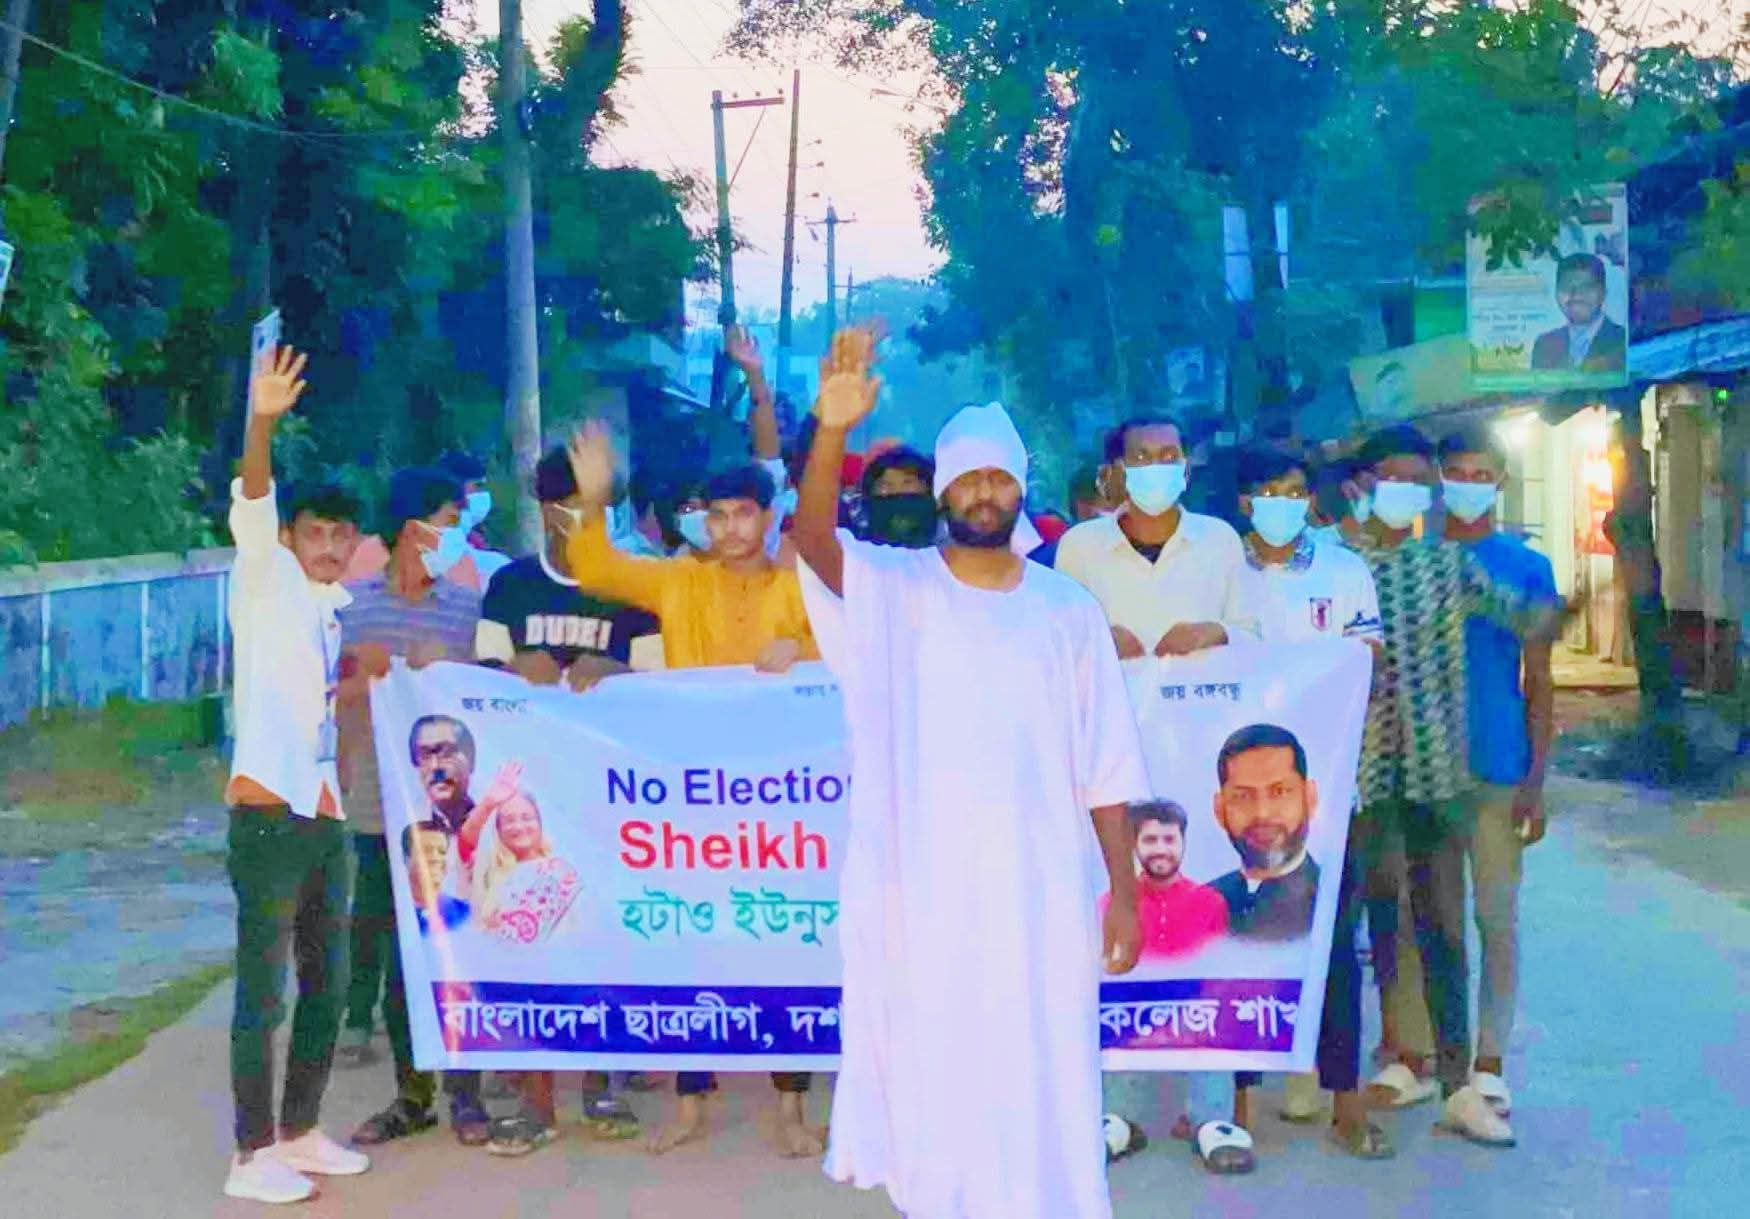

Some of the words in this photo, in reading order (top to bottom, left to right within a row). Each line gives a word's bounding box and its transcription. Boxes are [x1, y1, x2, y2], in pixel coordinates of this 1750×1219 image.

[1160, 684, 1185, 700] জয়
[607, 768, 667, 804] No
[684, 766, 851, 805] Electio
[620, 820, 828, 869] Sheikh
[617, 885, 714, 939] হটাও
[440, 999, 610, 1040] বাংলাদেশ
[620, 991, 774, 1048] ছাত্রলীগ,
[1100, 998, 1220, 1038] কলেজ
